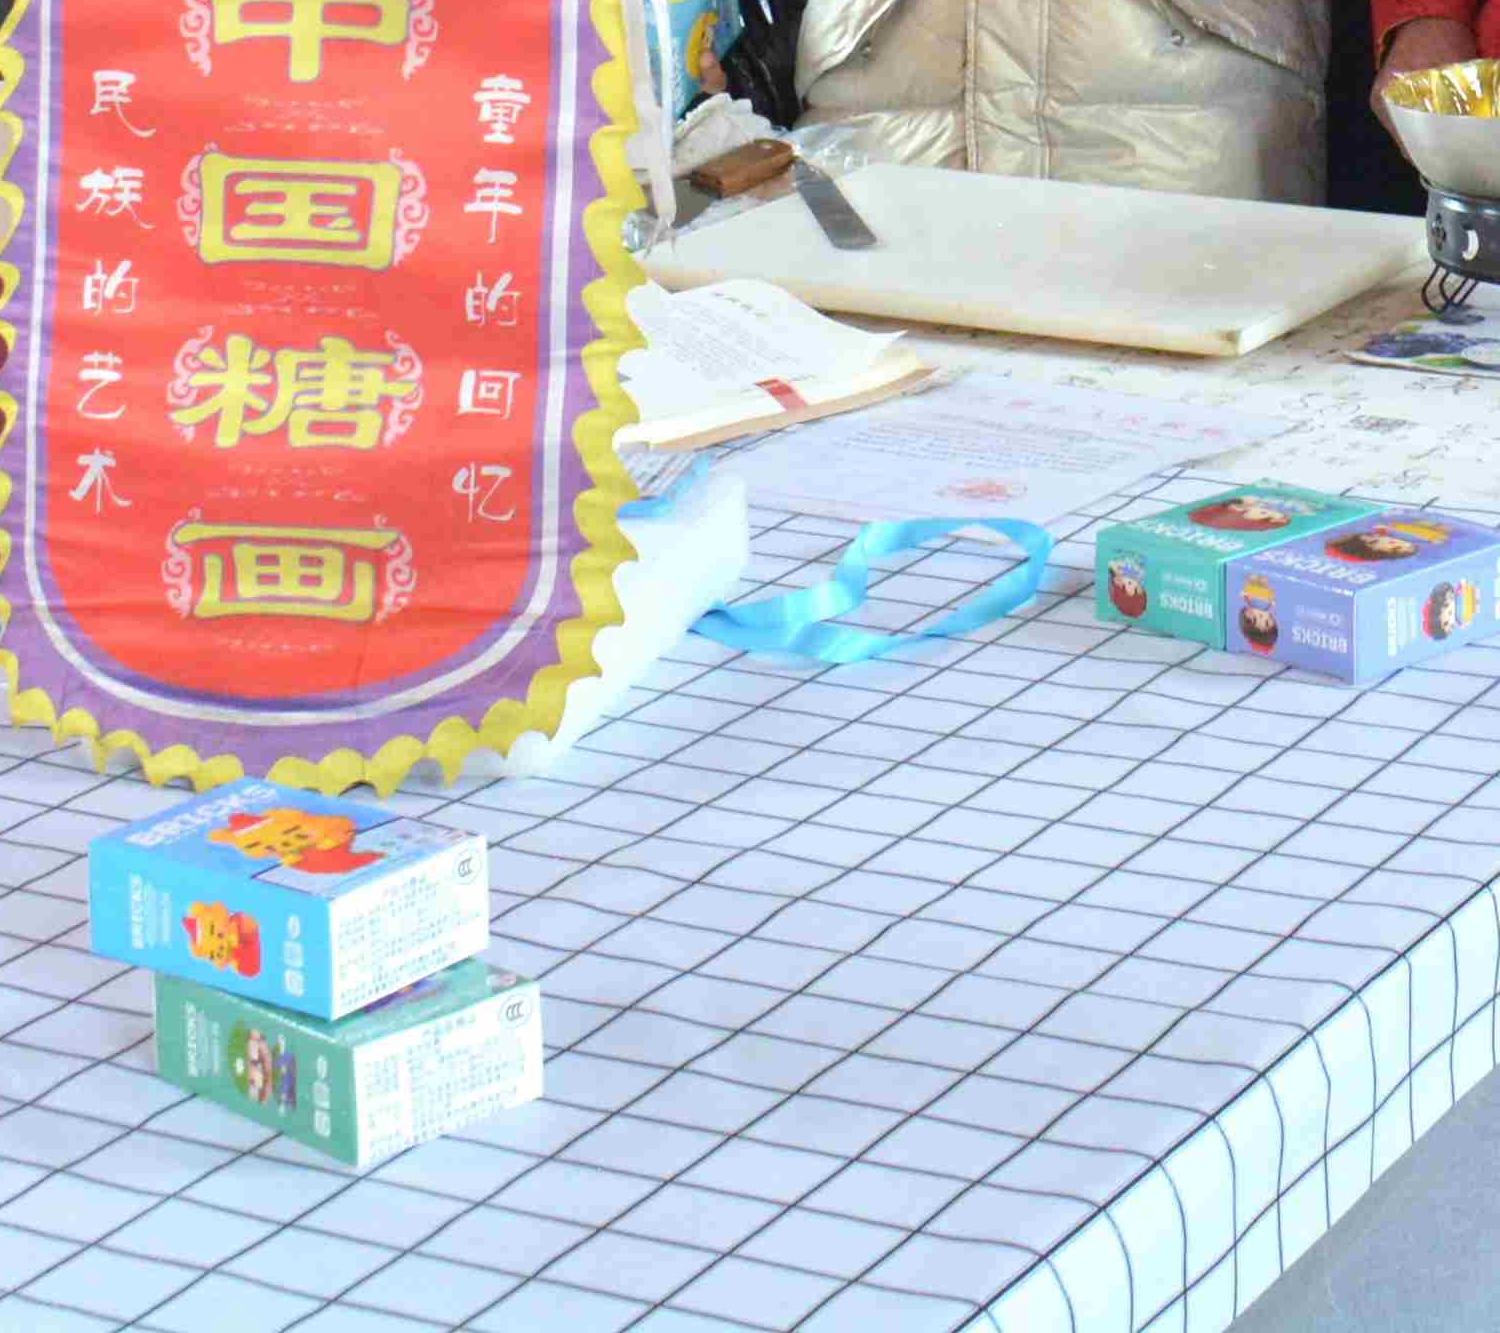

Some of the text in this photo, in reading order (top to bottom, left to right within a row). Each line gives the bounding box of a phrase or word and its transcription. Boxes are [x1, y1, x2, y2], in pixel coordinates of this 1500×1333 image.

[69, 70, 156, 512] 民族的艺术
[452, 74, 531, 522] 童年的回忆
